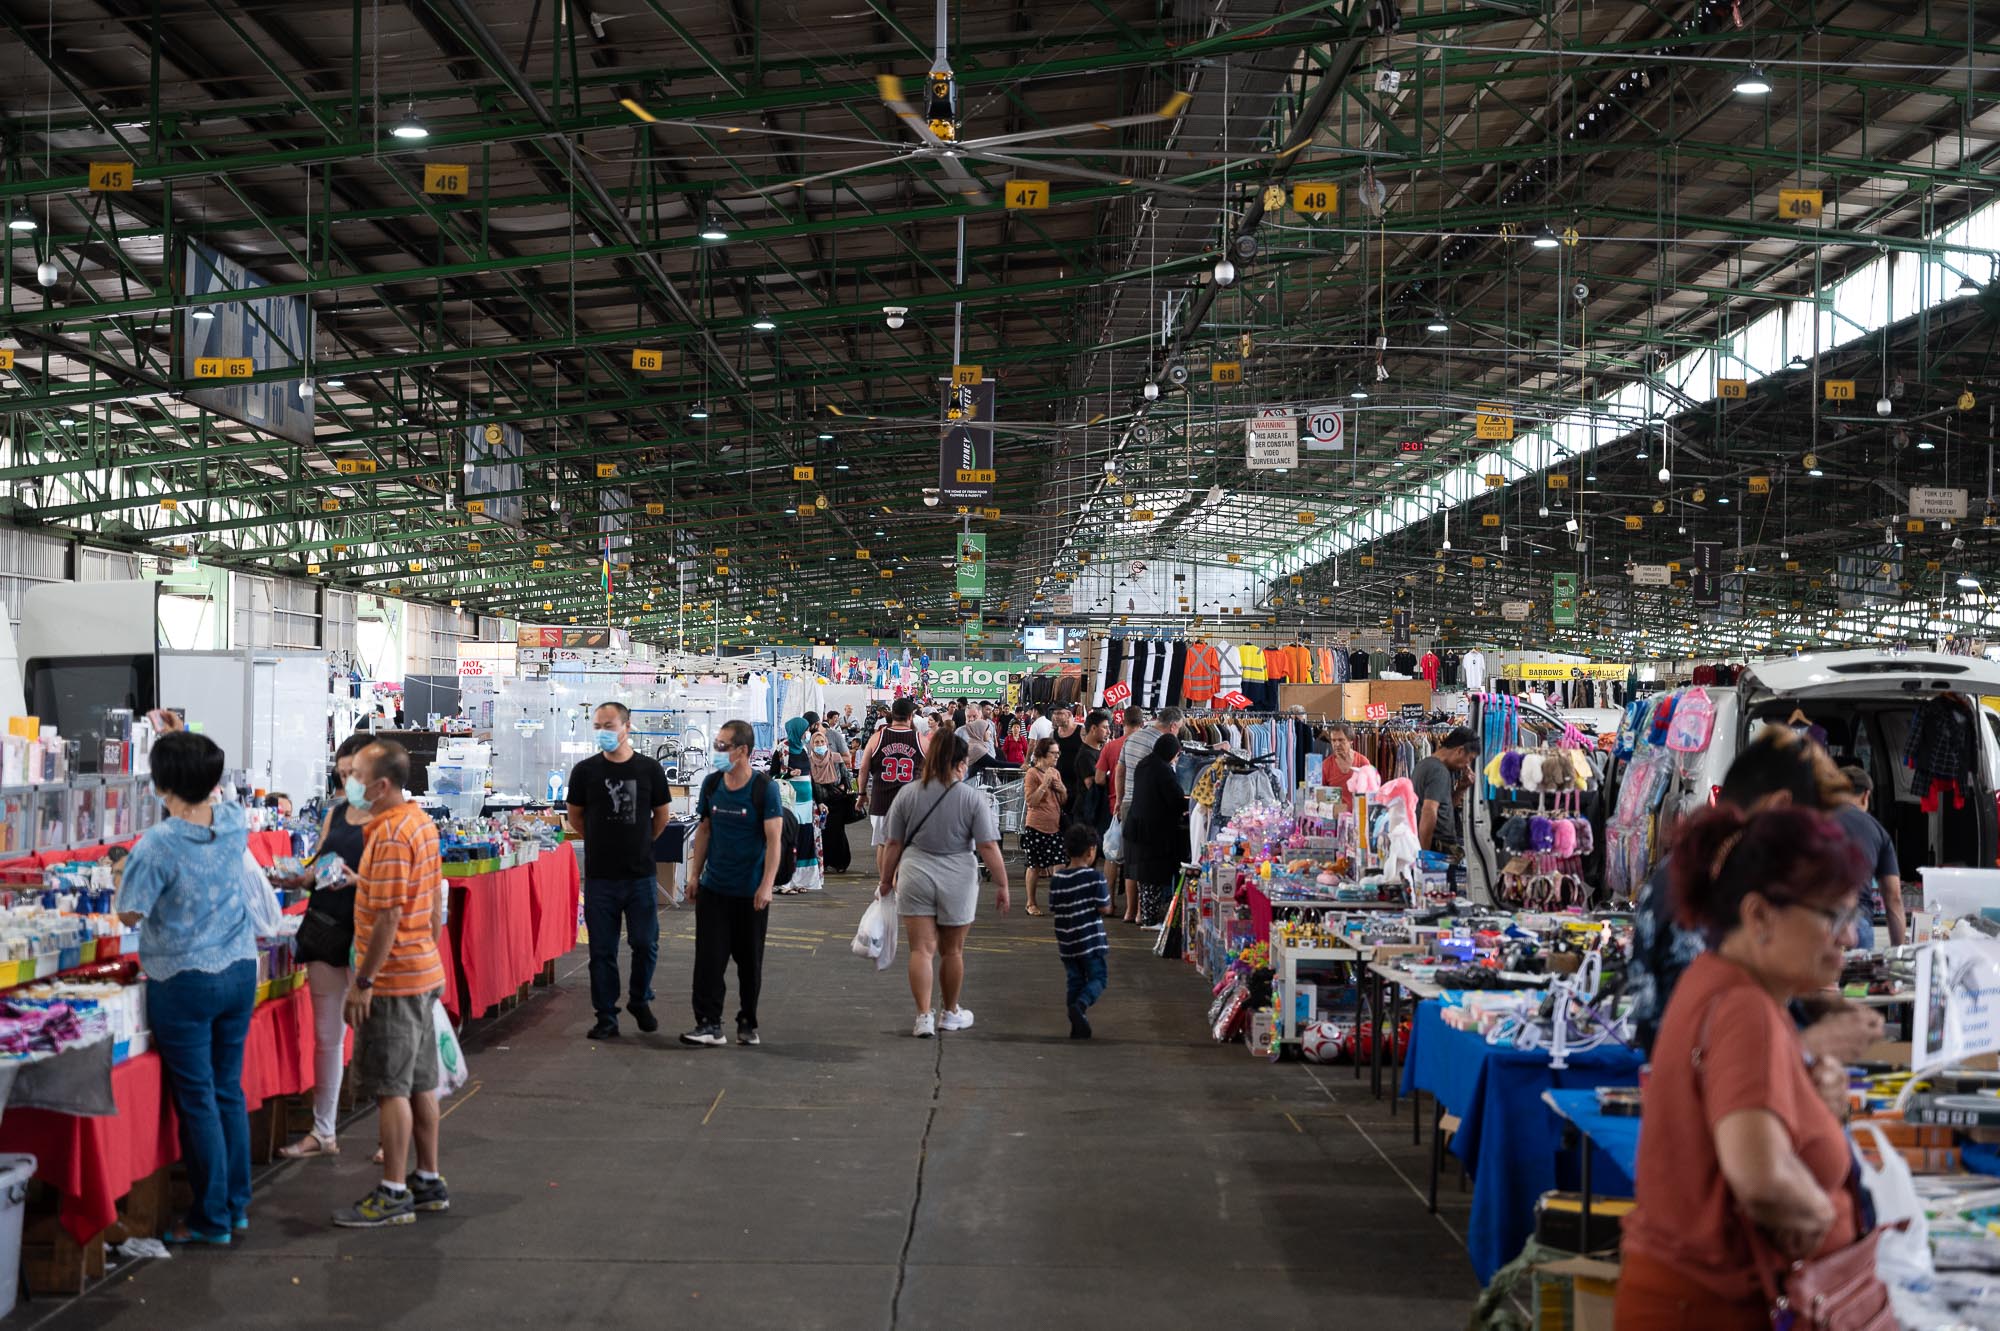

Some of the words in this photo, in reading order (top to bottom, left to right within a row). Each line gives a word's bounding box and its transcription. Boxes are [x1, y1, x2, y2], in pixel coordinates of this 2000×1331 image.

[100, 172, 121, 188] 45
[435, 175, 458, 192] 46
[1015, 190, 1038, 206] 47
[1303, 192, 1326, 208] 48
[1789, 199, 1812, 215] 49
[639, 356, 655, 368] 66
[201, 363, 217, 375] 64
[231, 363, 246, 375] 65
[1219, 369, 1235, 381] 68
[959, 372, 975, 383] 67
[1723, 384, 1740, 397] 69
[1832, 385, 1848, 398] 70
[1254, 421, 1286, 429] WARNING
[1313, 417, 1335, 434] 10
[962, 437, 972, 471] SYDNEY
[1252, 457, 1291, 465] SURVEILLANCE
[341, 463, 353, 472] 83
[960, 473, 972, 481] 87
[980, 473, 992, 481] 88
[1489, 479, 1502, 487] 89
[163, 502, 175, 510] 102
[325, 502, 337, 511] 103
[469, 504, 482, 512] 104
[458, 668, 483, 676] FOOD
[937, 686, 986, 695] Saturday
[1106, 684, 1127, 703] $10
[1225, 694, 1246, 706] 10
[1367, 704, 1385, 719] $15
[881, 757, 914, 782] 33
